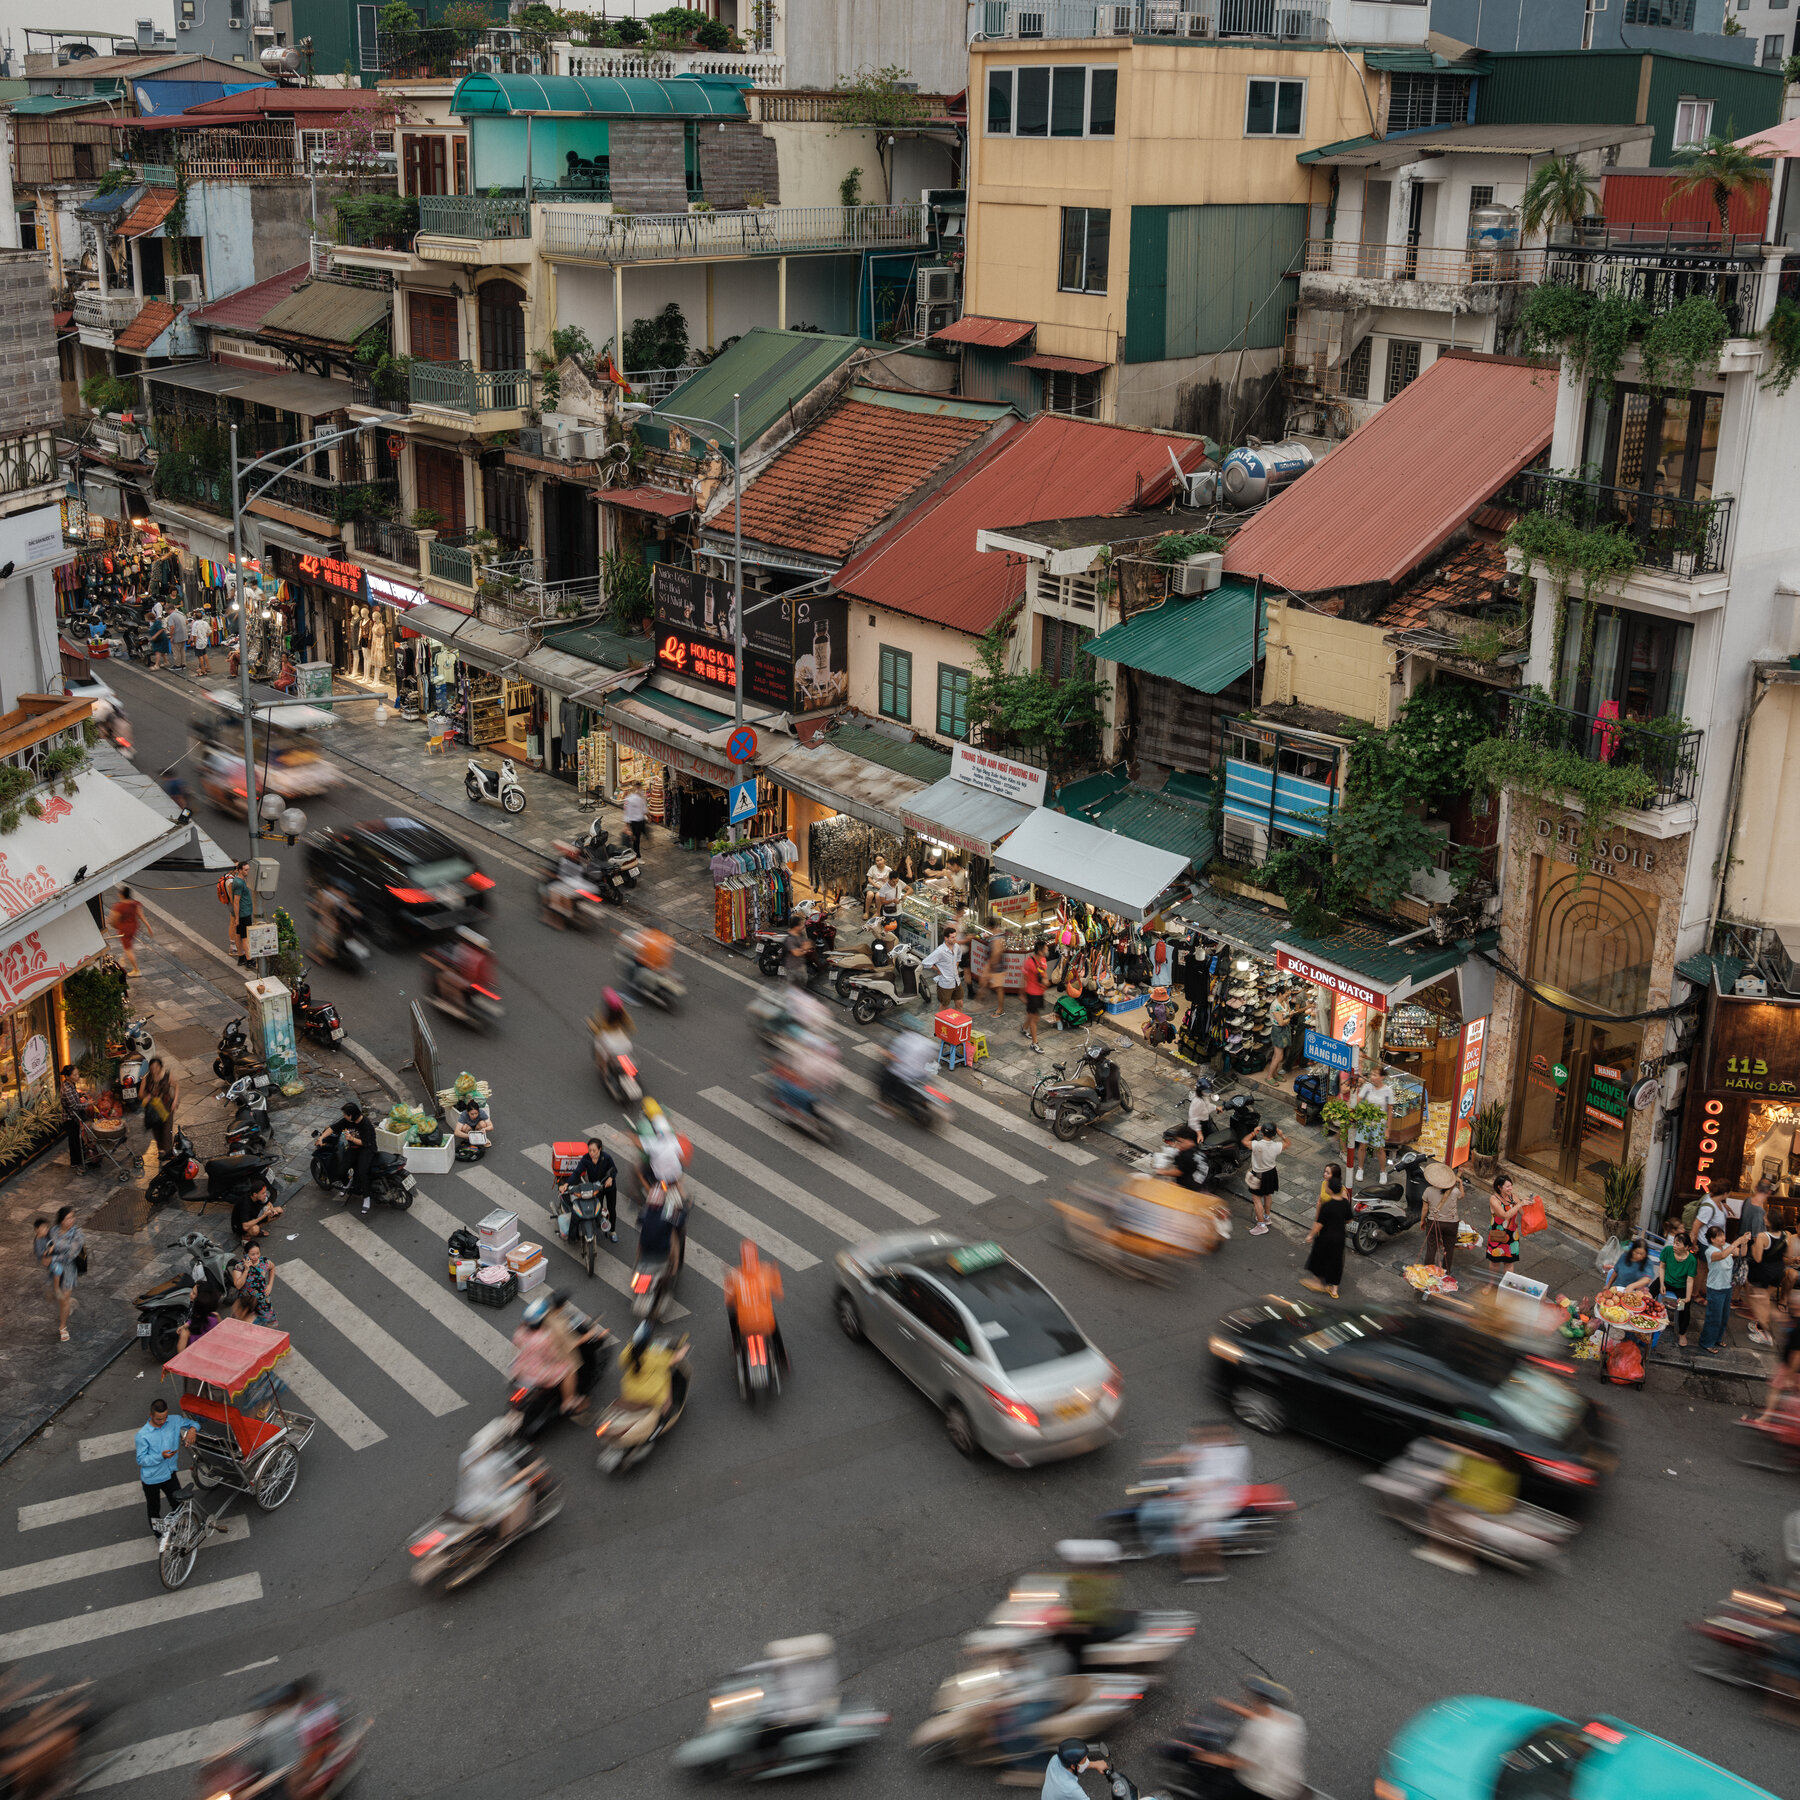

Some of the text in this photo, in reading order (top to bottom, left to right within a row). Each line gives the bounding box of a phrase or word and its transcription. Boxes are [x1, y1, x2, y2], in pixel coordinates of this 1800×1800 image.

[320, 557, 340, 571] HONG
[340, 561, 361, 579] KONG
[659, 635, 687, 668] Lệ
[690, 642, 717, 663] HONG
[717, 650, 744, 671] KON
[961, 750, 976, 762] TRUNG
[987, 759, 998, 769] ANH
[904, 816, 925, 832] ĐỒNG
[1288, 958, 1374, 1004] ĐỨC LONG WATCH
[1322, 1040, 1337, 1050] PHỐ
[1309, 1044, 1348, 1067] HÀNG ĐÀO
[1463, 1058, 1480, 1072] LONG
[1597, 1066, 1618, 1078] HANOI
[1727, 1057, 1769, 1075] 113
[1462, 1068, 1478, 1085] WATCH
[1589, 1077, 1626, 1103] TRAVEL
[1586, 1092, 1627, 1118] AGENCY
